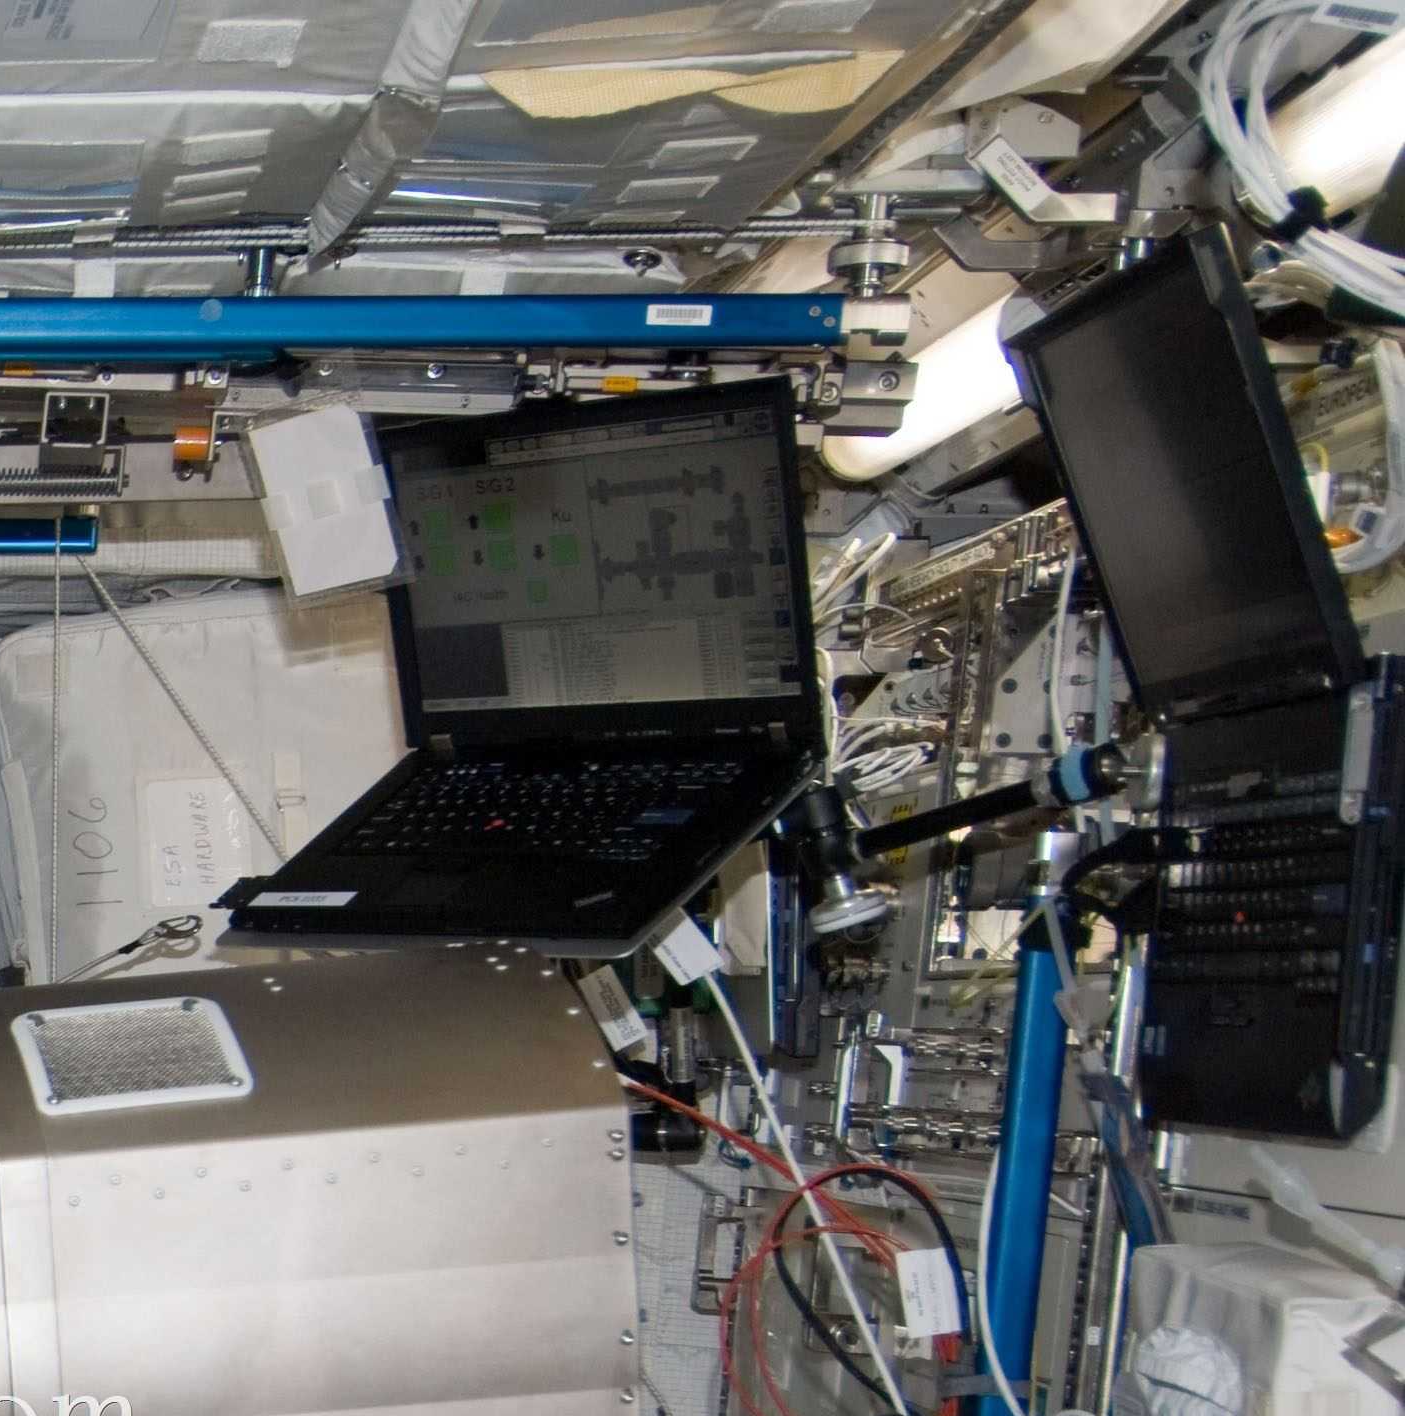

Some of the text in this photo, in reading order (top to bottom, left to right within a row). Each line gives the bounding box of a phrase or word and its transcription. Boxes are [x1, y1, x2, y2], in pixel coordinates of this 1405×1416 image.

[68, 797, 123, 906] 1106
[162, 844, 182, 889] ESA
[188, 790, 216, 886] HARDWARE
